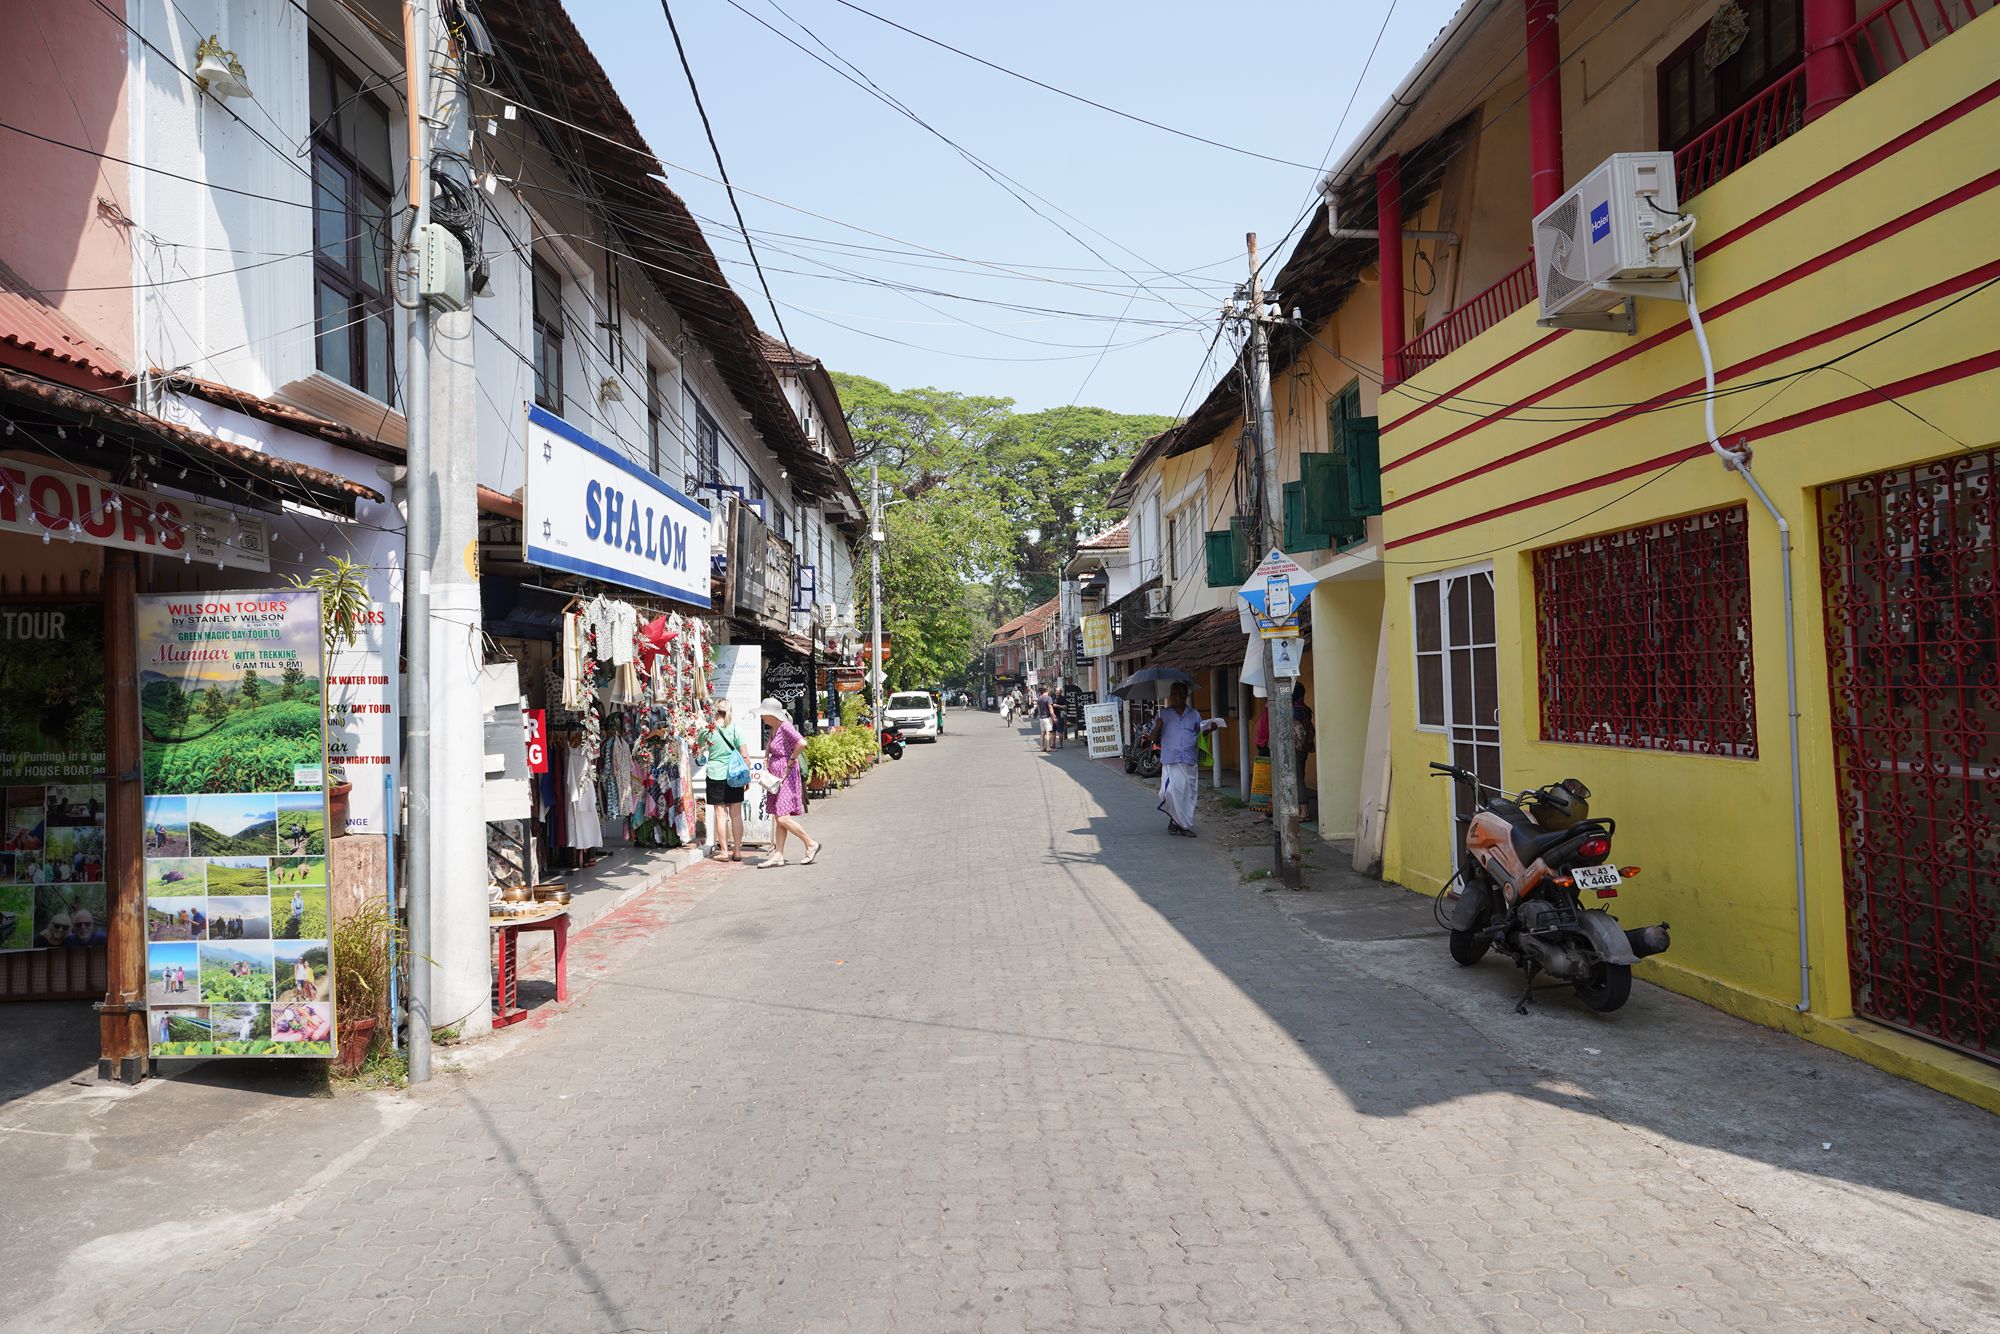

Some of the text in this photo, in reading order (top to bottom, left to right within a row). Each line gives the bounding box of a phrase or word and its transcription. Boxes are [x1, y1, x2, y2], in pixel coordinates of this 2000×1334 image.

[1592, 214, 1609, 232] Haier
[0, 467, 185, 551] TOURS
[585, 479, 687, 572] SHALOM
[197, 545, 214, 556] Tours
[168, 601, 288, 615] WILSON TOURS
[172, 613, 284, 625] by STANLEY WILSON
[2, 612, 66, 640] TOUR
[178, 629, 280, 641] GREEN MAGIC DAY TOUR TO
[152, 644, 230, 662] Munnar
[235, 650, 297, 660] WITH TREKKING
[232, 662, 241, 671] (6
[260, 661, 276, 669] TILL
[279, 661, 284, 669] 9
[286, 660, 303, 670] PM)
[339, 675, 366, 685] WATER
[368, 675, 389, 685] TOUR
[351, 704, 367, 714] DAY
[369, 704, 391, 714] TOUR
[1091, 714, 1113, 724] FABRICS
[1091, 724, 1115, 734] CLOTHING
[1092, 734, 1116, 744] YOGA MAT
[19, 751, 65, 764] (Punting)
[69, 751, 78, 761] in
[346, 755, 369, 765] NIGHT
[371, 755, 391, 765] TOUR
[2, 766, 12, 777] in
[15, 768, 22, 776] a
[24, 765, 60, 776] HOUSE
[64, 765, 90, 776] BOAT
[1597, 867, 1609, 875] 43
[1579, 874, 1618, 887] K 4469
